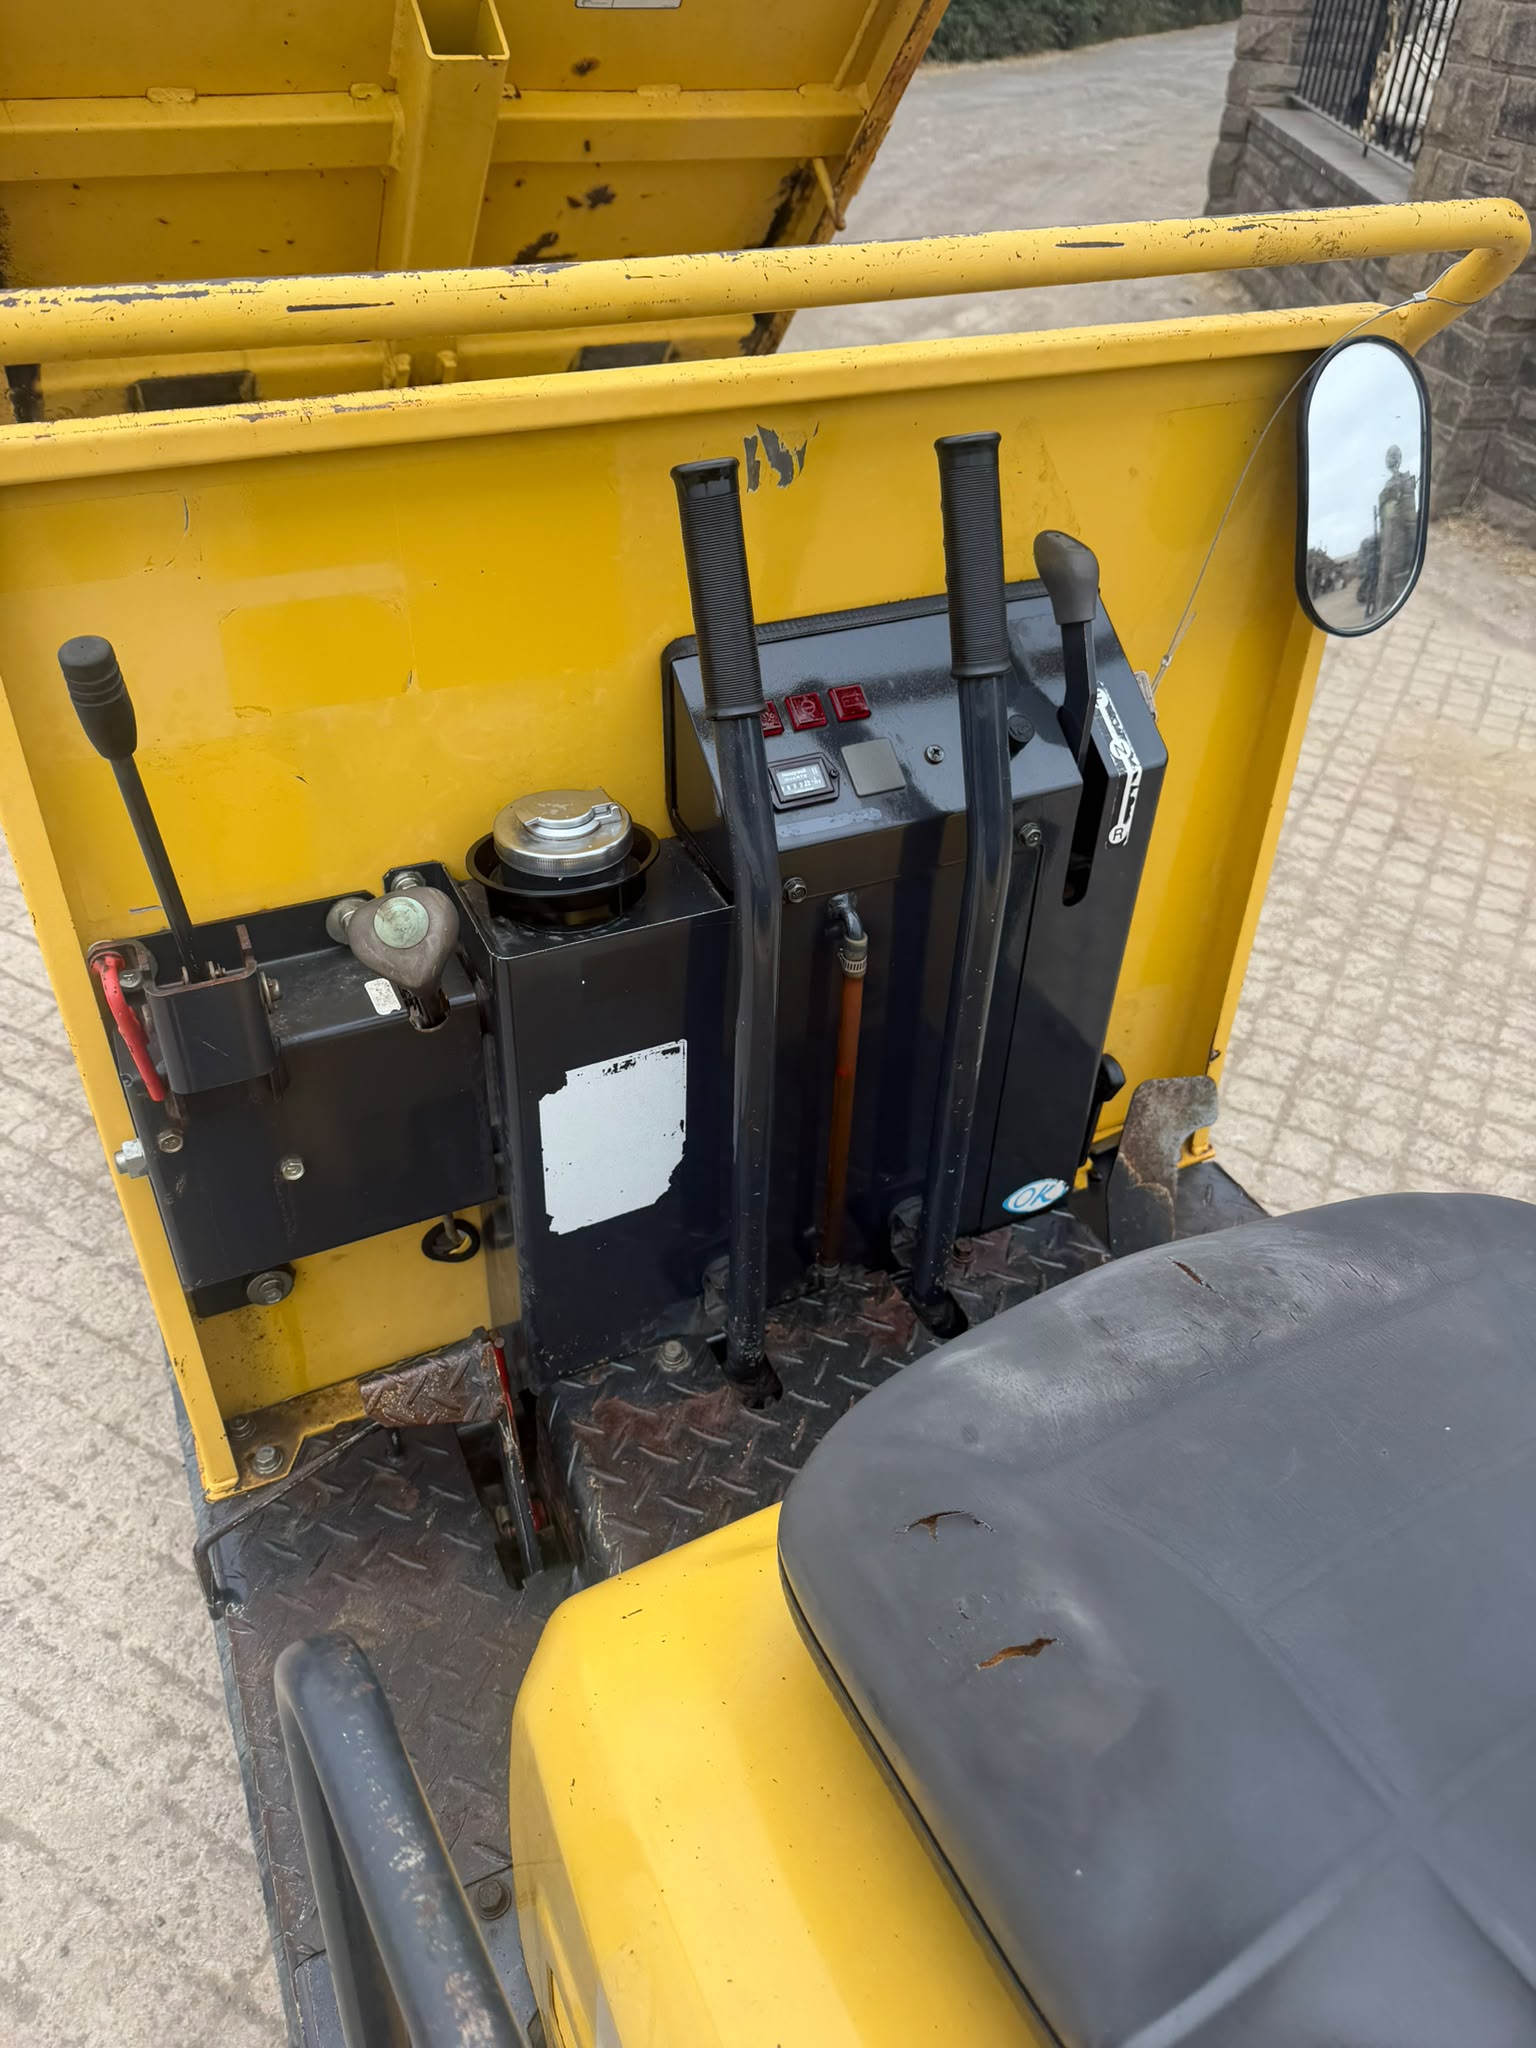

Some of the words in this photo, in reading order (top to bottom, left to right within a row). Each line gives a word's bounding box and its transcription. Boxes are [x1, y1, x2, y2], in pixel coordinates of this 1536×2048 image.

[1113, 742, 1128, 757] N
[1112, 827, 1124, 841] R
[1013, 1183, 1055, 1209] OK
